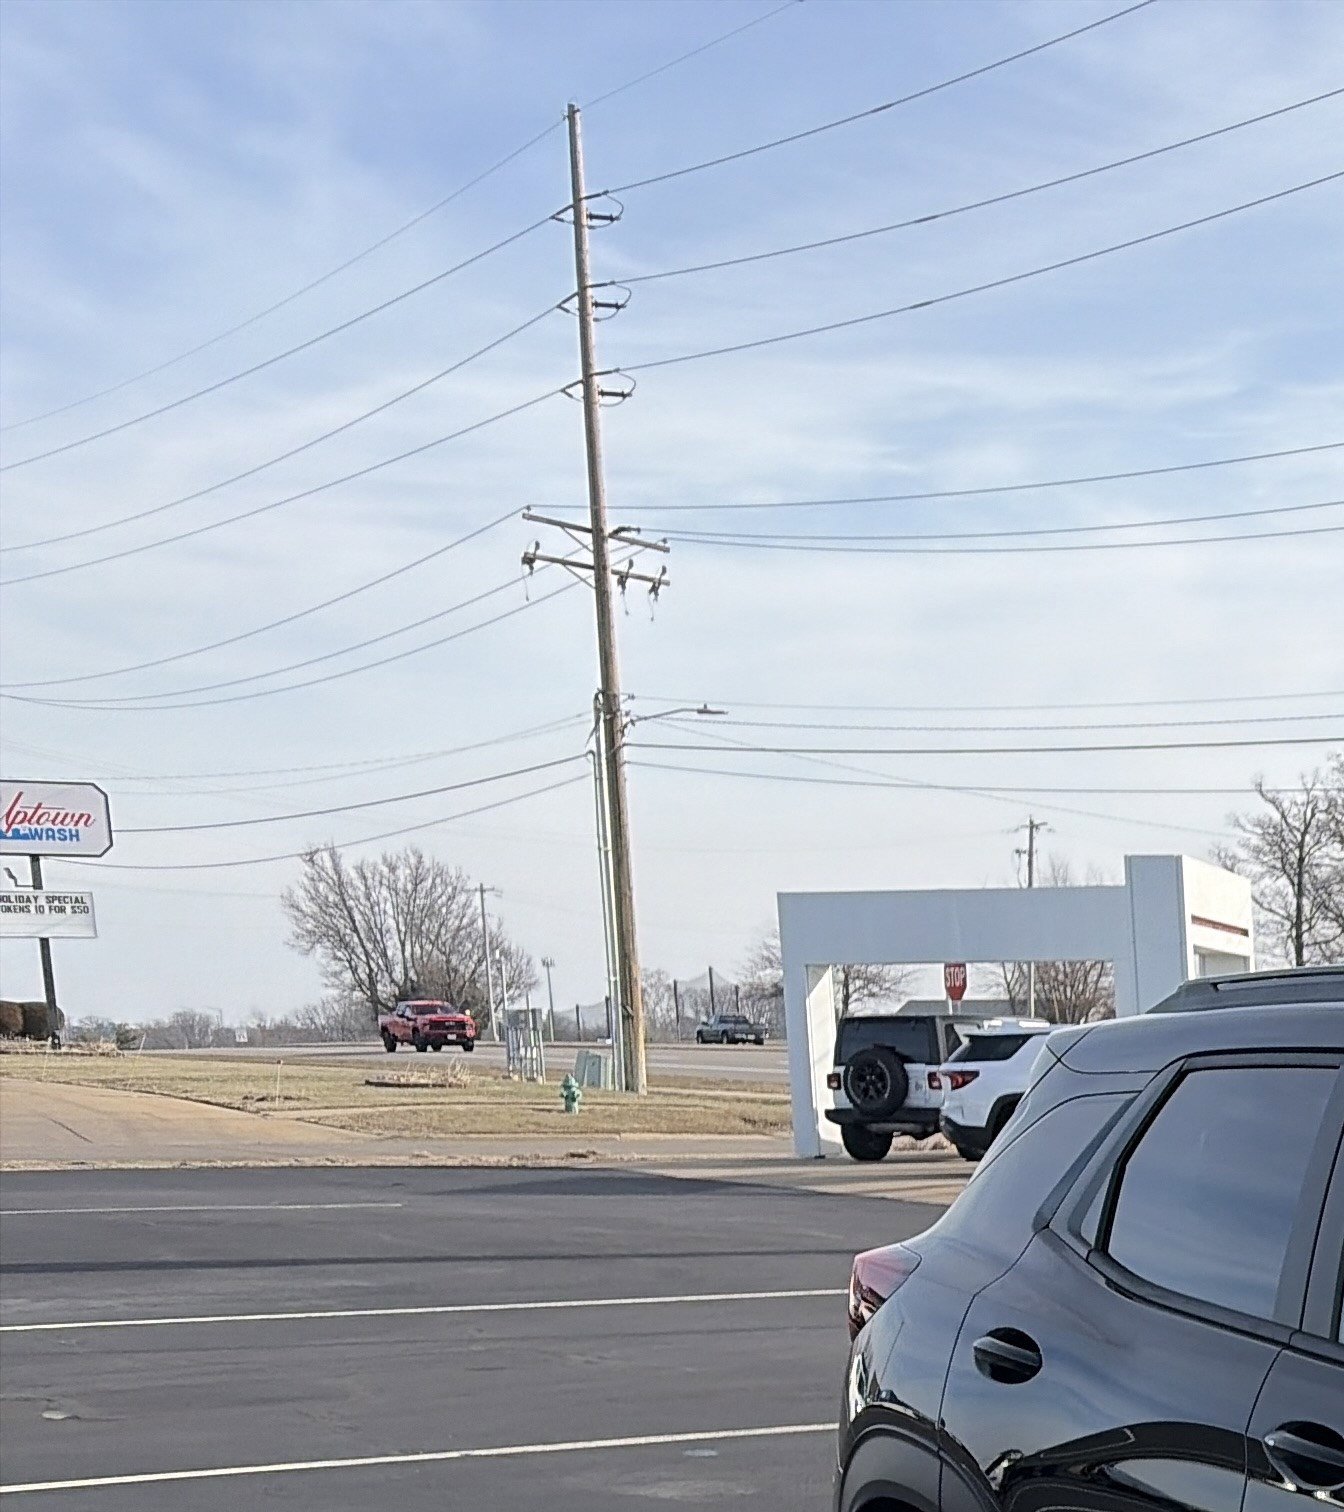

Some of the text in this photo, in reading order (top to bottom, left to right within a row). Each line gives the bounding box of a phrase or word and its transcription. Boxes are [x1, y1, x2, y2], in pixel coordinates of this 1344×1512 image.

[28, 827, 80, 842] WASH
[45, 895, 87, 905] SPECIAL
[0, 904, 32, 914] OKENS
[48, 905, 67, 914] FOR
[945, 966, 966, 988] STOP
